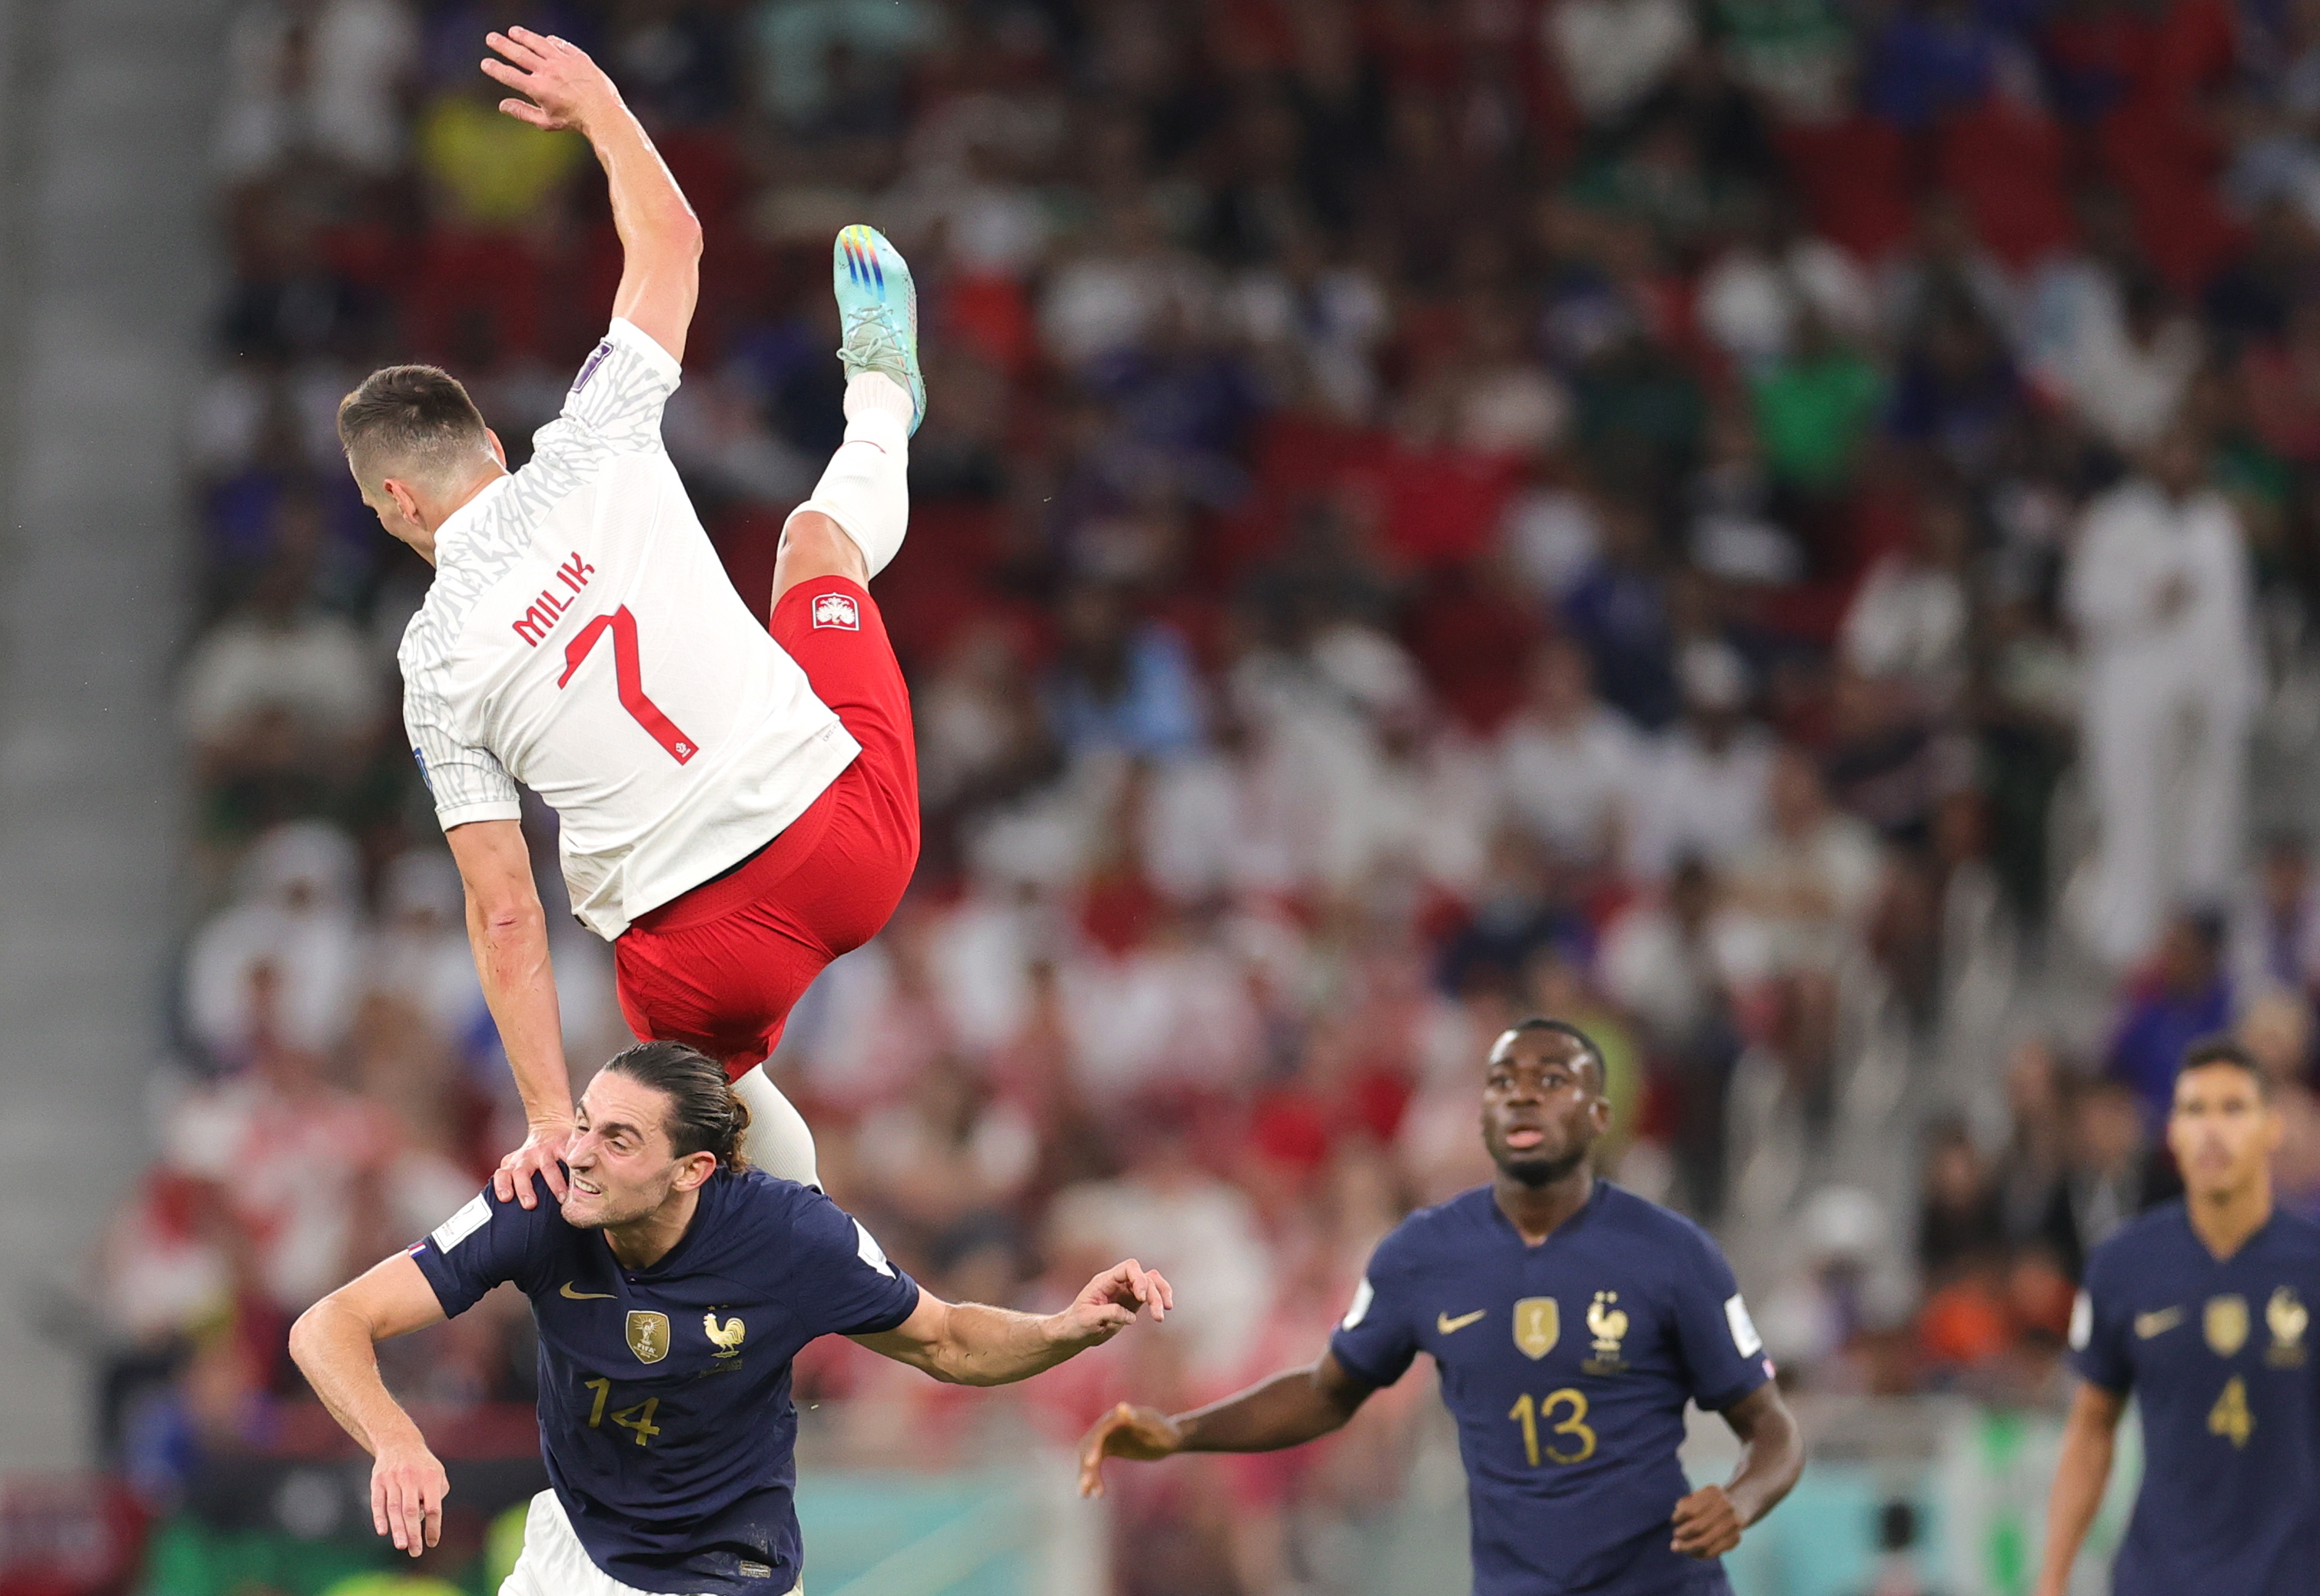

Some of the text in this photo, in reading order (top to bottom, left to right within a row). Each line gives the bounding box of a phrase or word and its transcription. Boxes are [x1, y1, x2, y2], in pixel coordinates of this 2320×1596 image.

[513, 551, 595, 647] MILIK
[557, 603, 699, 766] 7
[585, 1377, 661, 1446] 14
[1509, 1388, 1597, 1467] 13
[2208, 1377, 2254, 1447] 4
